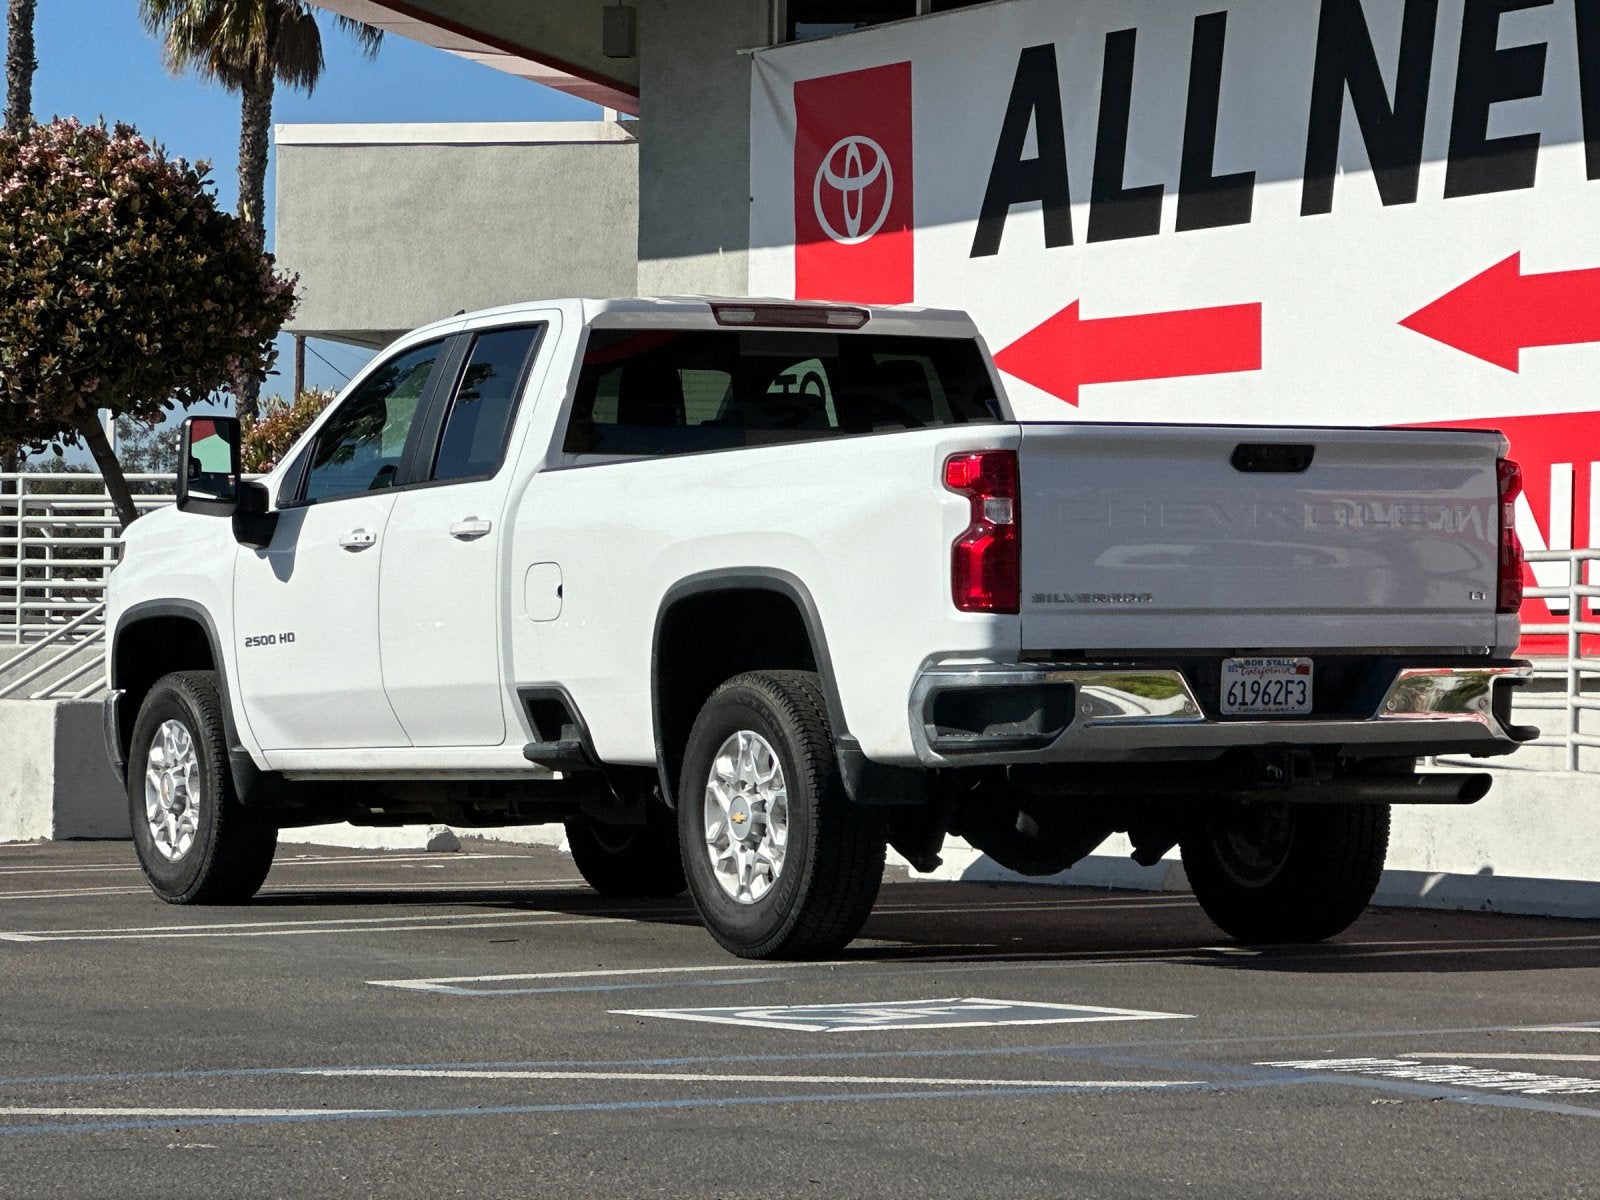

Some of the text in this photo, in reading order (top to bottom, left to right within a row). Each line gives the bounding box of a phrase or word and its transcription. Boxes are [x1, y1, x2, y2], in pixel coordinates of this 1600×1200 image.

[969, 0, 1600, 258] ALL NE
[245, 632, 295, 647] 2500 HD
[1245, 659, 1264, 667] BOB
[1227, 680, 1307, 706] 61962F3
